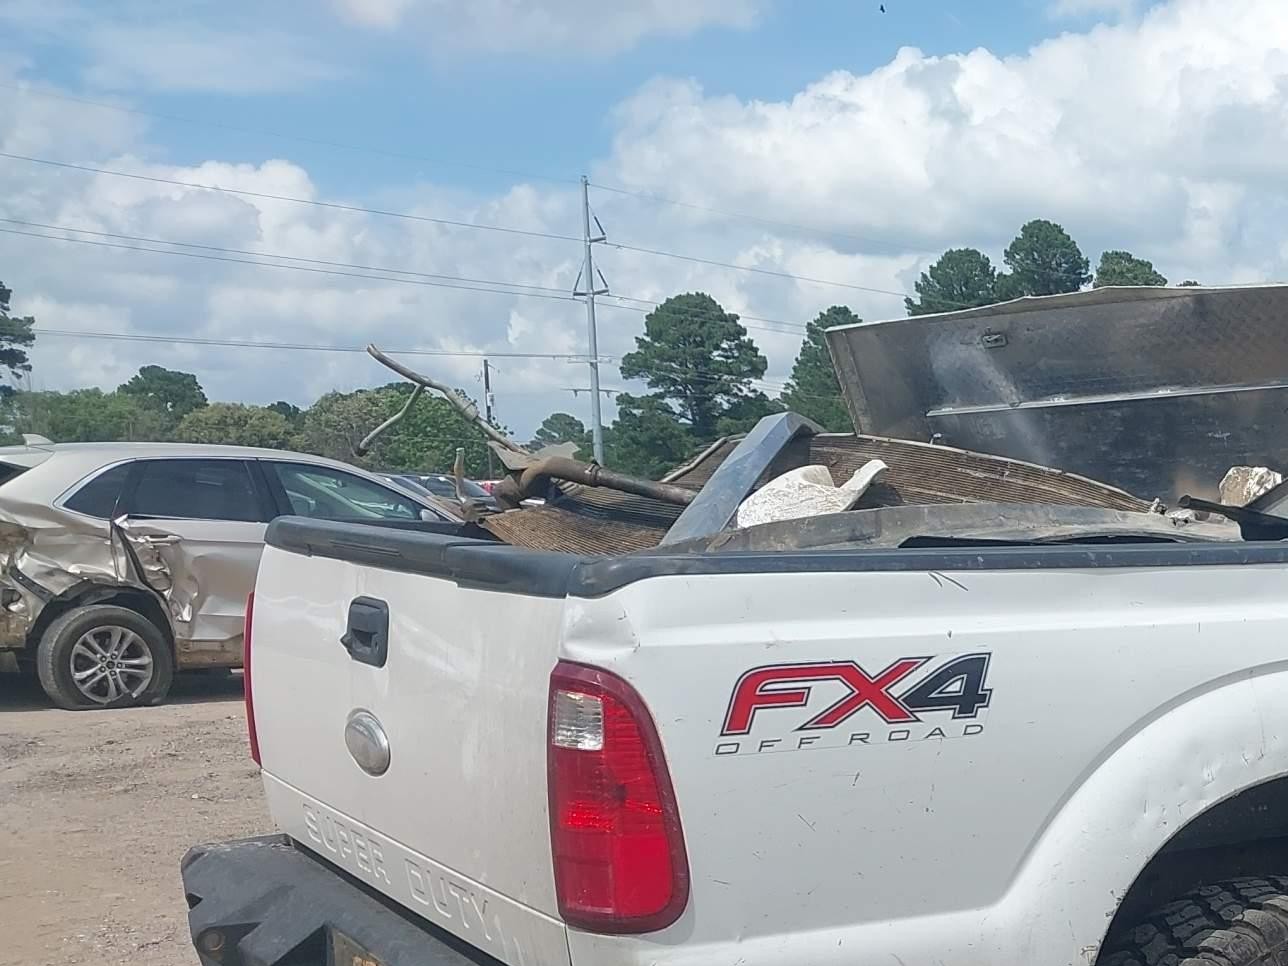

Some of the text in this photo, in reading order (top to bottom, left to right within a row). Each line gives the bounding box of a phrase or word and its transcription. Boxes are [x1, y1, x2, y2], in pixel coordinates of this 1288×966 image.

[718, 652, 993, 737] FX4
[714, 723, 984, 756] OFF ROAD
[302, 803, 492, 942] SUPER DUTY
